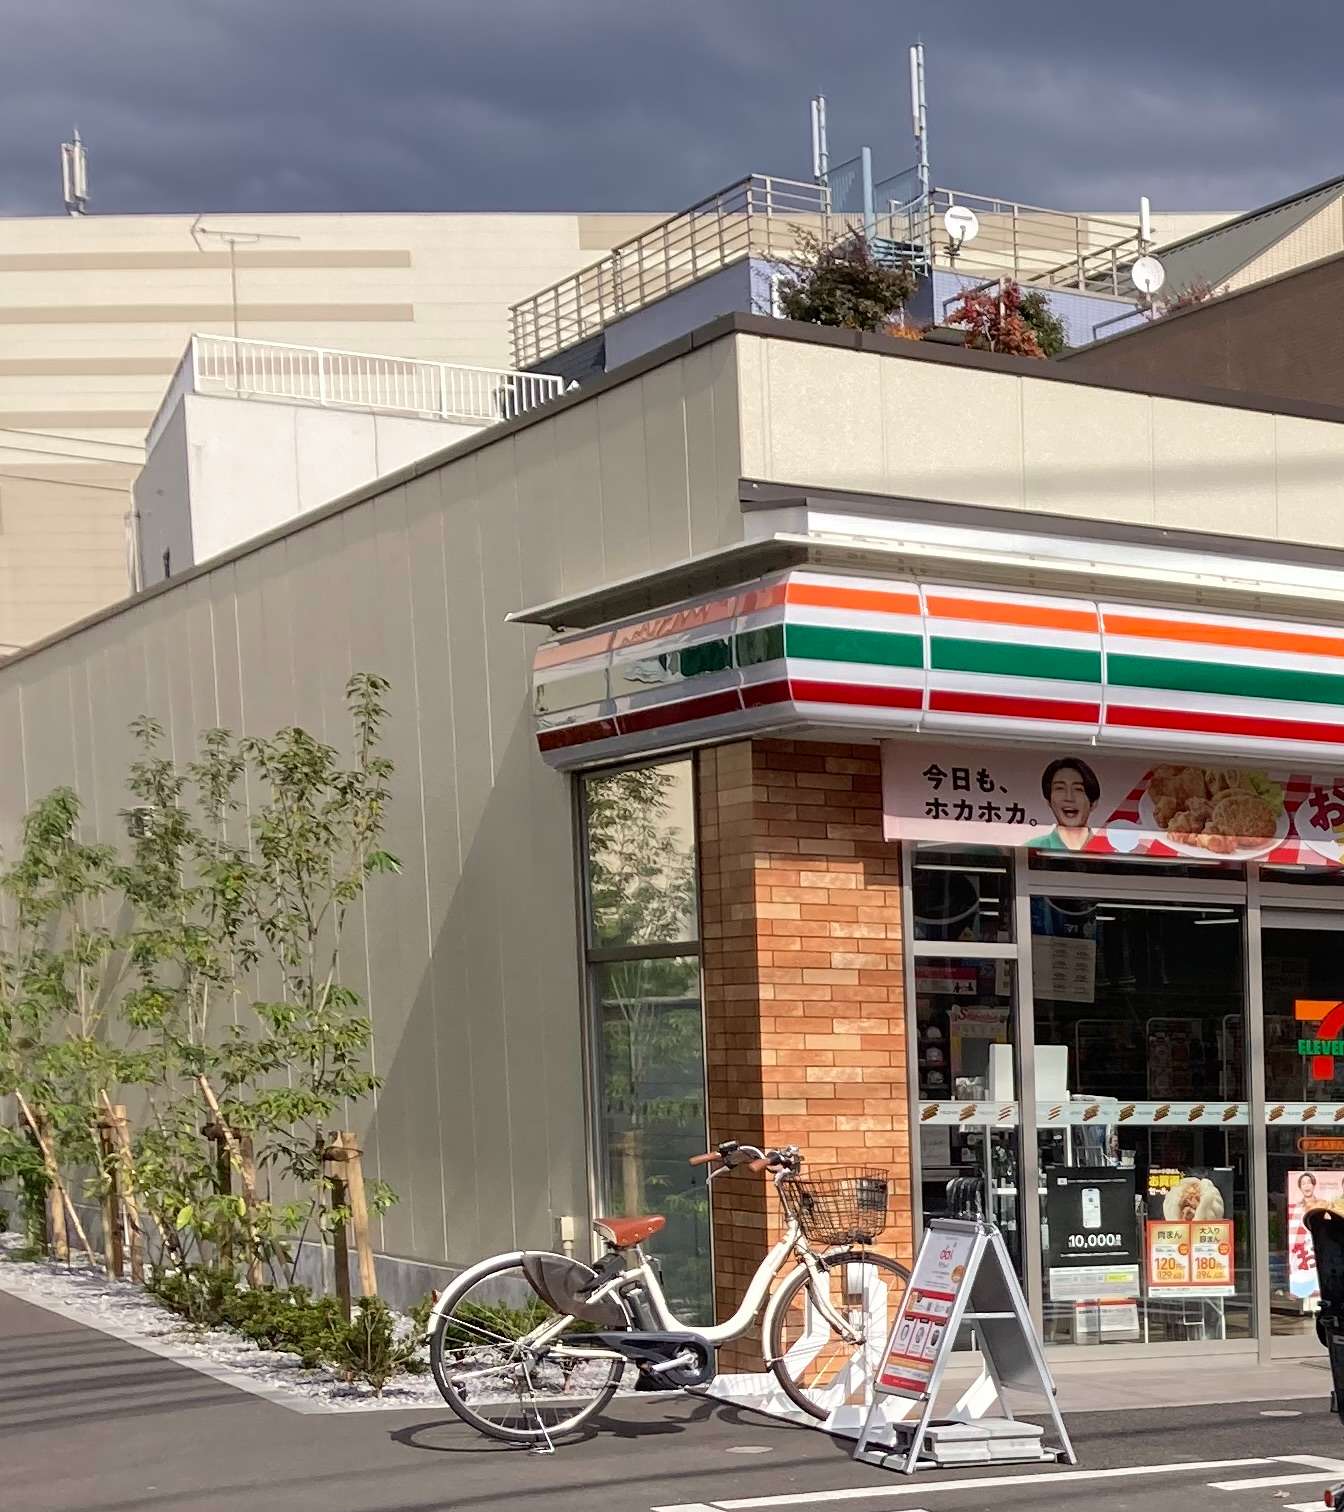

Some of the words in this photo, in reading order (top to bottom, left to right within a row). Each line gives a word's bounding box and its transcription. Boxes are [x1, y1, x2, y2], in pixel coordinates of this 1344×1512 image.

[922, 764, 1009, 794] 今日も、
[924, 797, 1038, 827] ホカホカ。
[1068, 1234, 1115, 1248] 10,000
[1155, 1257, 1176, 1270] 120
[1195, 1257, 1216, 1270] 180
